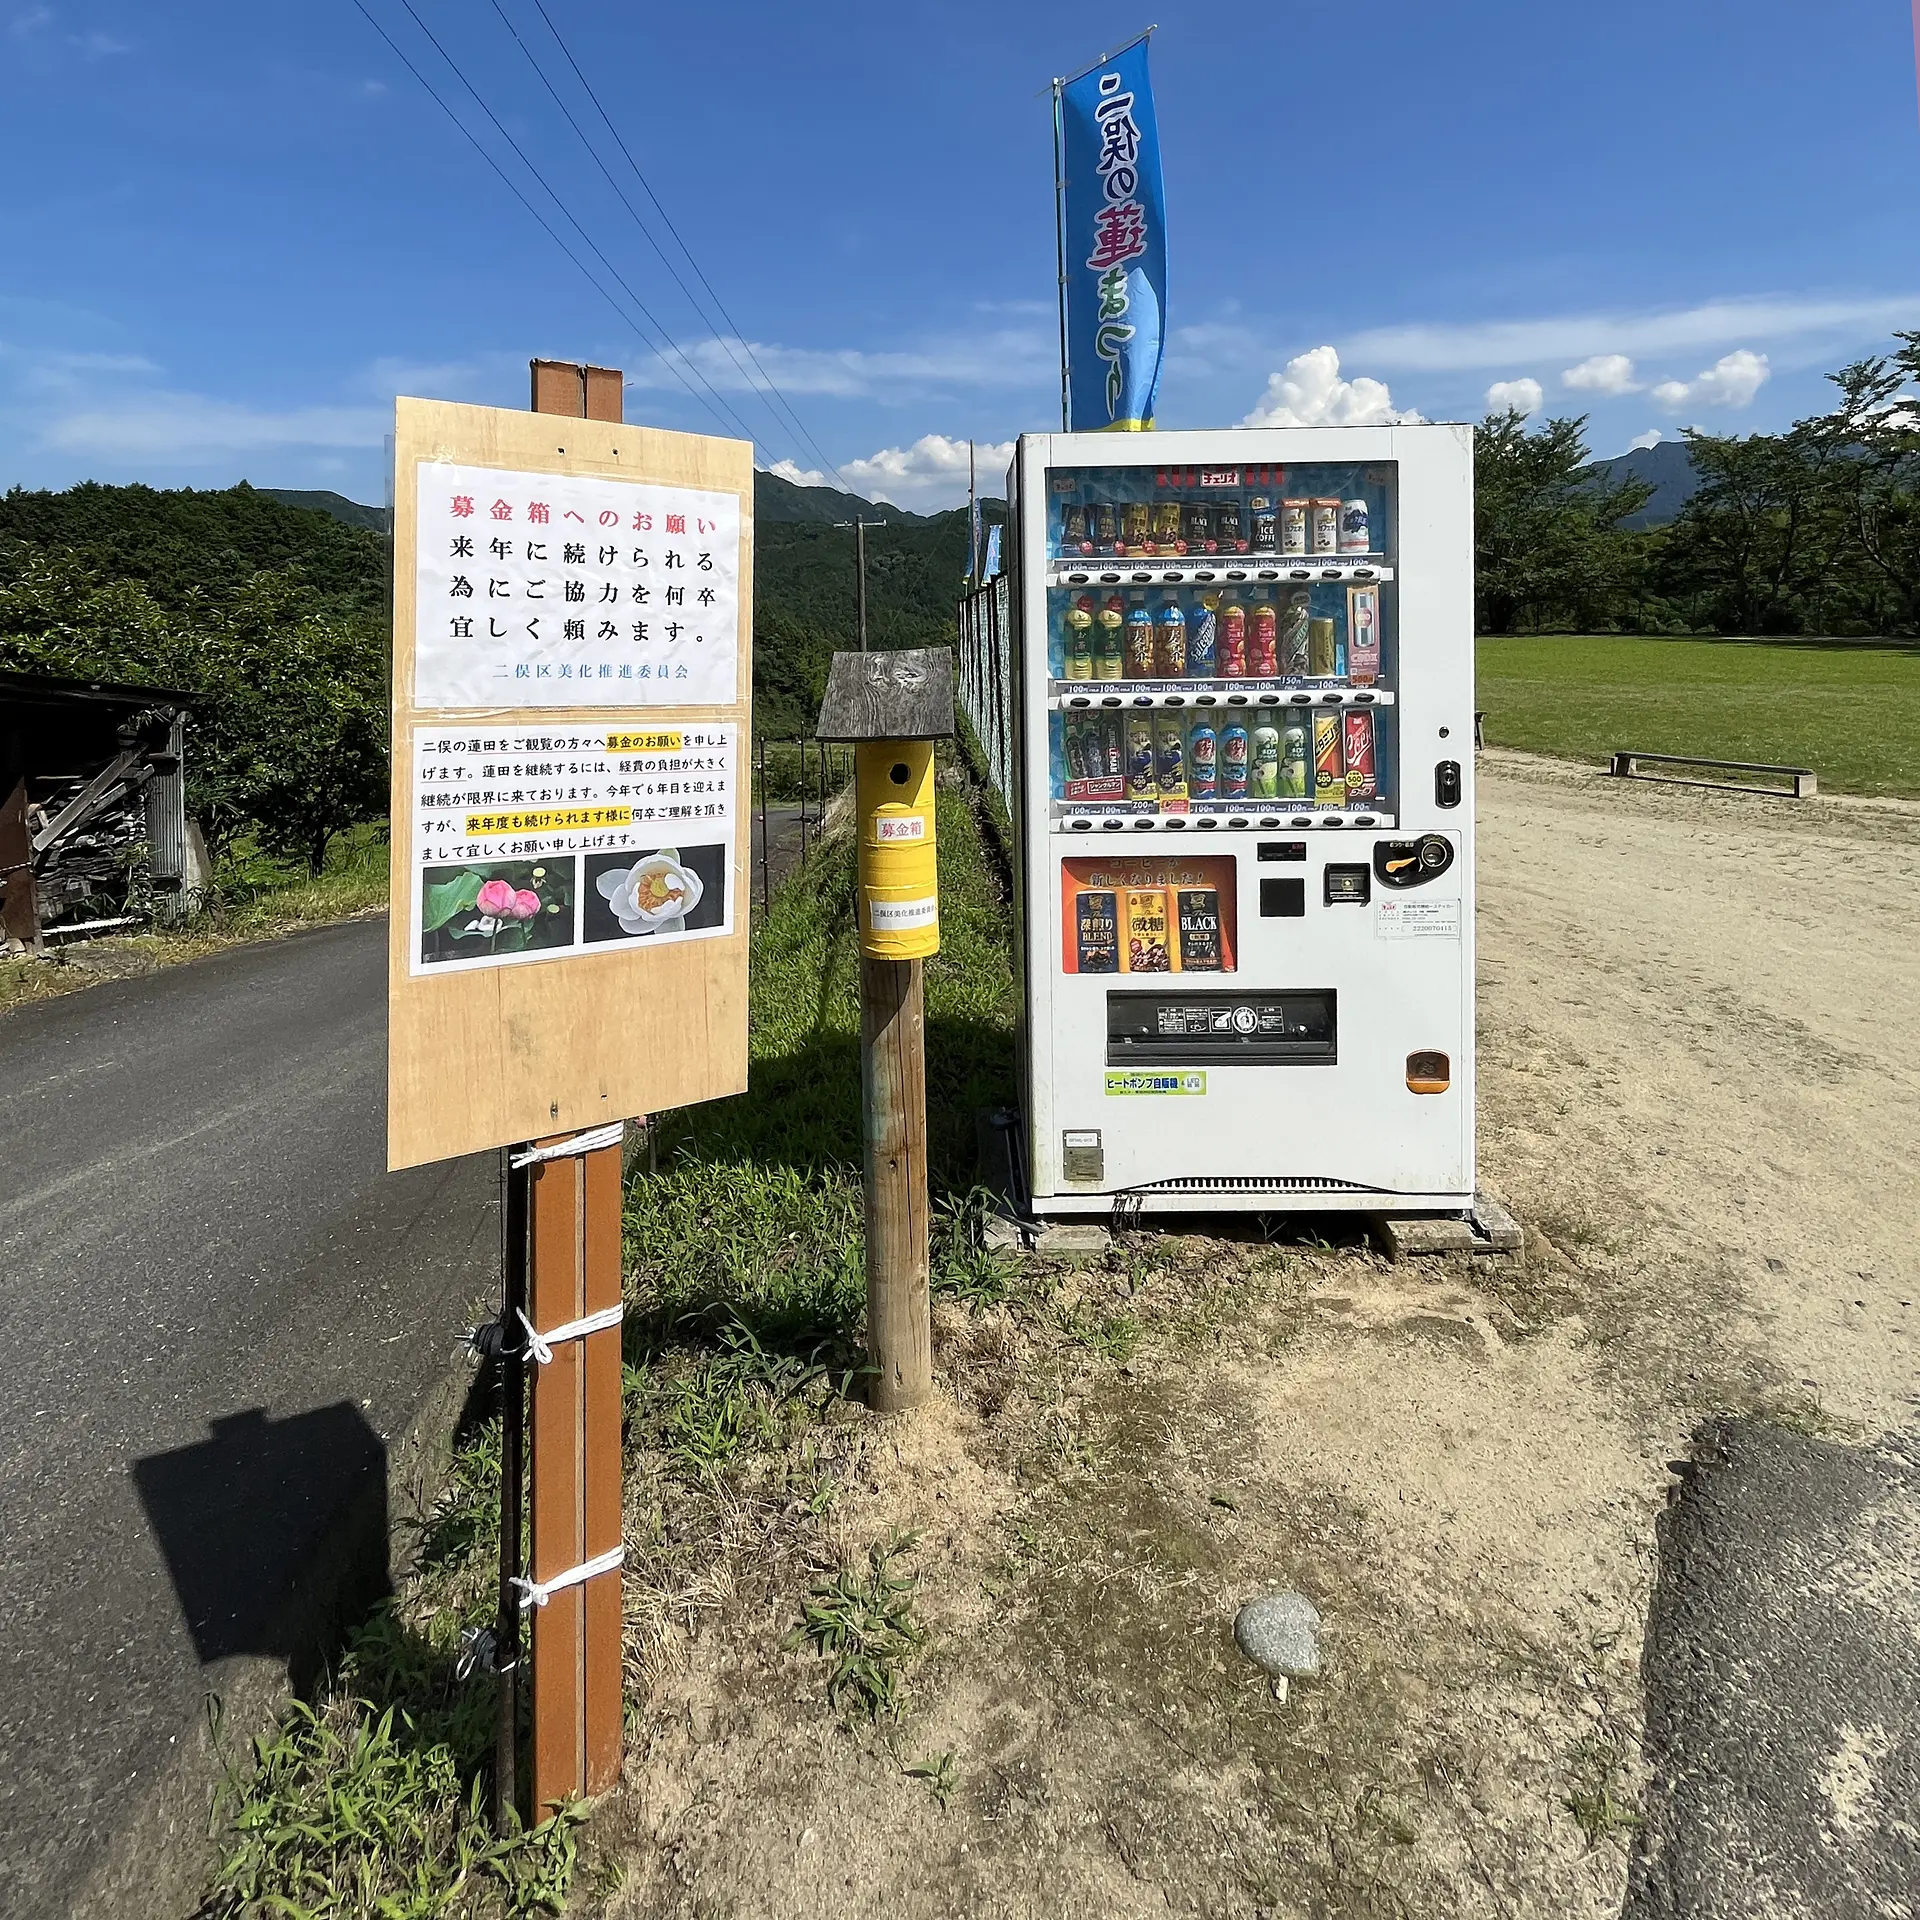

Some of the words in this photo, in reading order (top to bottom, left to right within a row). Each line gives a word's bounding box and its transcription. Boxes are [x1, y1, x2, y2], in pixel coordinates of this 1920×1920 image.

[1203, 472, 1237, 484] チェリオ
[449, 495, 716, 535] 募金箱へのお願い
[1261, 526, 1274, 534] ICE
[449, 535, 714, 571] 来年に続けられる
[449, 575, 716, 607] 為にご協力を何卒
[449, 615, 704, 643] 宜しく頼みます。
[1133, 629, 1148, 662] 麦茶
[1168, 629, 1183, 662] 麦茶
[492, 663, 689, 680] 二俣区美化推進委員会
[421, 733, 727, 753] 二俣の蓮田をご観覧の方々へ募金のお願いを申し上
[422, 756, 726, 780] げます。蓮田を継続するには、経費の負担が大きく
[421, 780, 726, 808] 継続が限界に来ております。今年で6年目を迎えま
[421, 803, 726, 834] すが、来年度も続けられます様に何卒ご理解を頂き
[881, 821, 922, 837] 募金箱
[421, 833, 637, 860] まして宜しくお願い申し上げます。
[1080, 917, 1114, 932] 深煎り
[1132, 917, 1165, 932] 微糖
[1181, 916, 1217, 931] BLACK
[1082, 931, 1114, 942] BLEND
[1107, 1077, 1179, 1090] ヒートポンプ自販機
